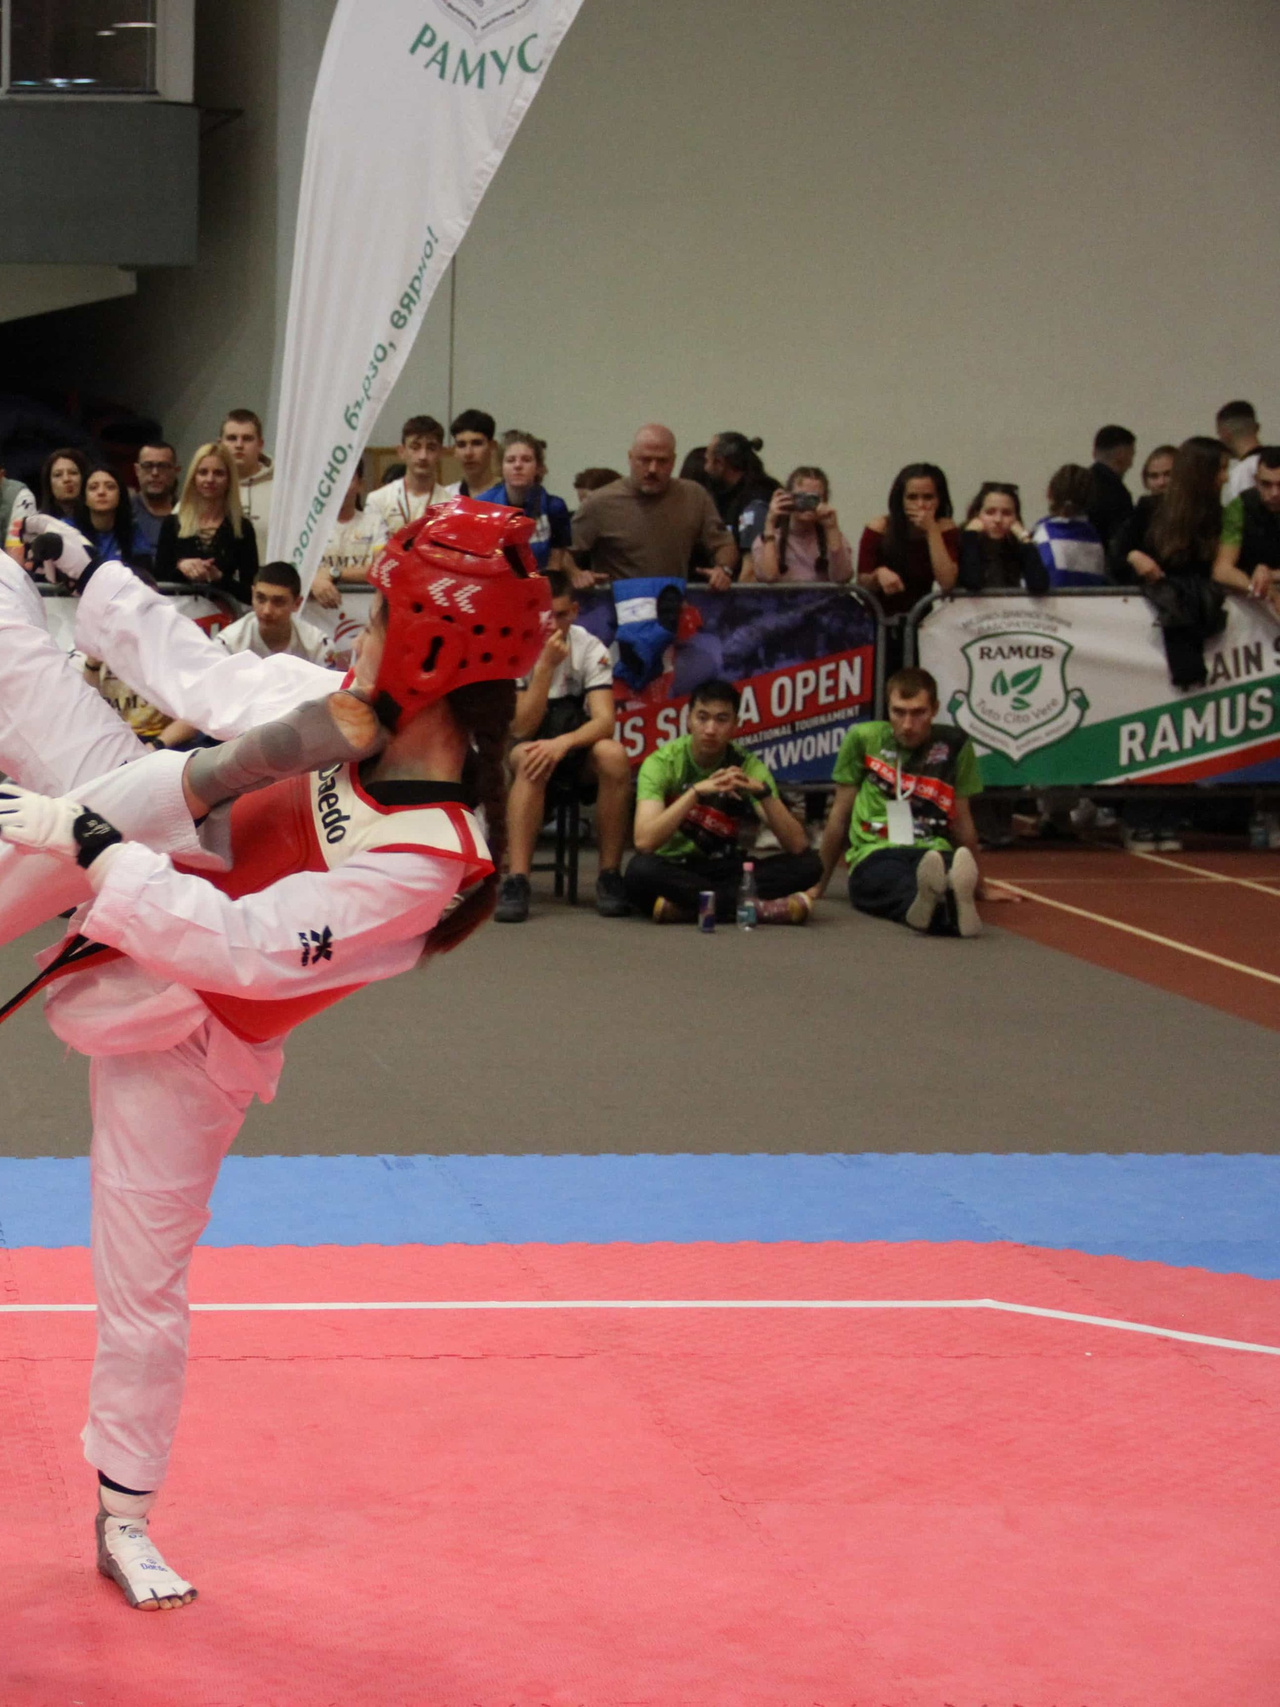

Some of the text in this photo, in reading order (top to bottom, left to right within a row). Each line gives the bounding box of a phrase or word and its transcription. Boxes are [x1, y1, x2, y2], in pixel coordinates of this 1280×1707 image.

[290, 443, 353, 569] зопасно,
[979, 645, 1055, 660] RAMUS
[1210, 642, 1263, 685] AIN
[771, 656, 862, 718] OPEN
[1119, 687, 1273, 767] RAMUS
